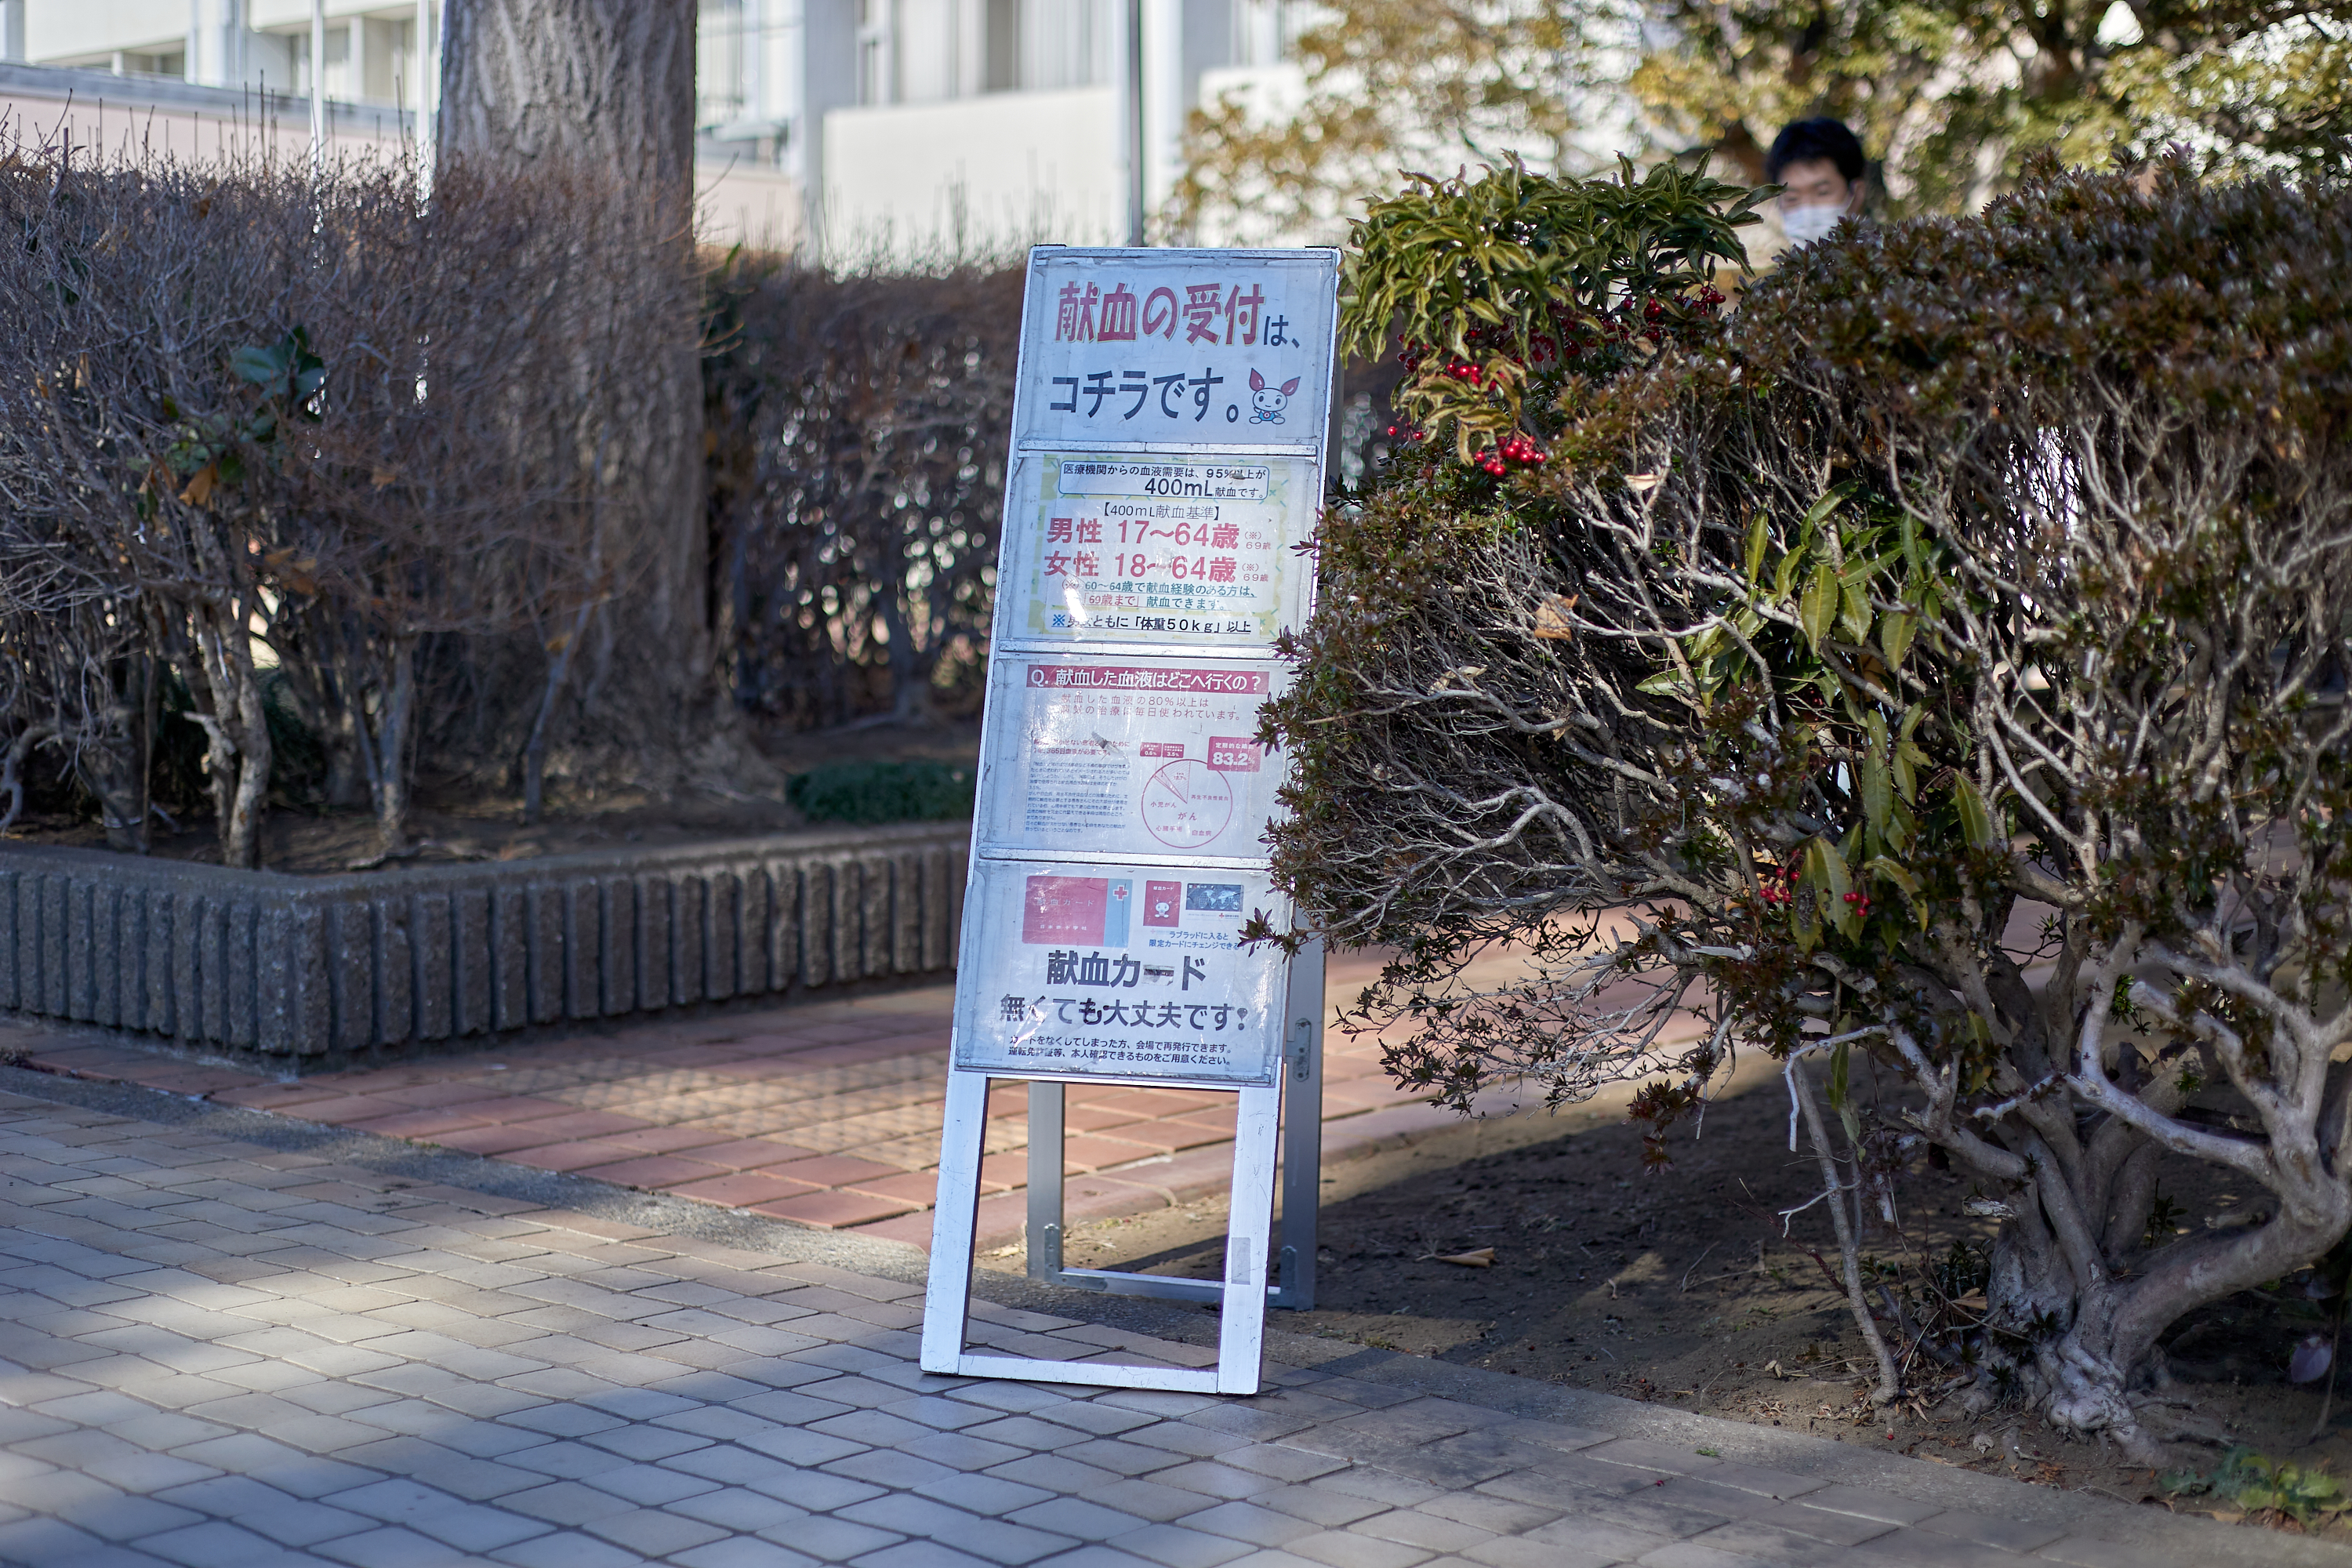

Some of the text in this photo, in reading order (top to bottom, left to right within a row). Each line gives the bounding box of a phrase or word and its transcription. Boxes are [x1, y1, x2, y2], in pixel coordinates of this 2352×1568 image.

[1055, 280, 1301, 349] 献血の受付は、
[1050, 367, 1240, 423] コチラです。
[1047, 518, 1102, 543] 男性
[1044, 550, 1099, 576] 女性
[1062, 694, 1209, 707] 献血した血液の80%以上は
[1212, 751, 1255, 766] 83.2%
[1178, 811, 1197, 821] がん
[1169, 931, 1229, 940] ラブラッドに入ると
[1046, 949, 1207, 991] 献血カード
[1010, 1035, 1231, 1054] カドをなくしてしまった方、会場で再発行できます。
